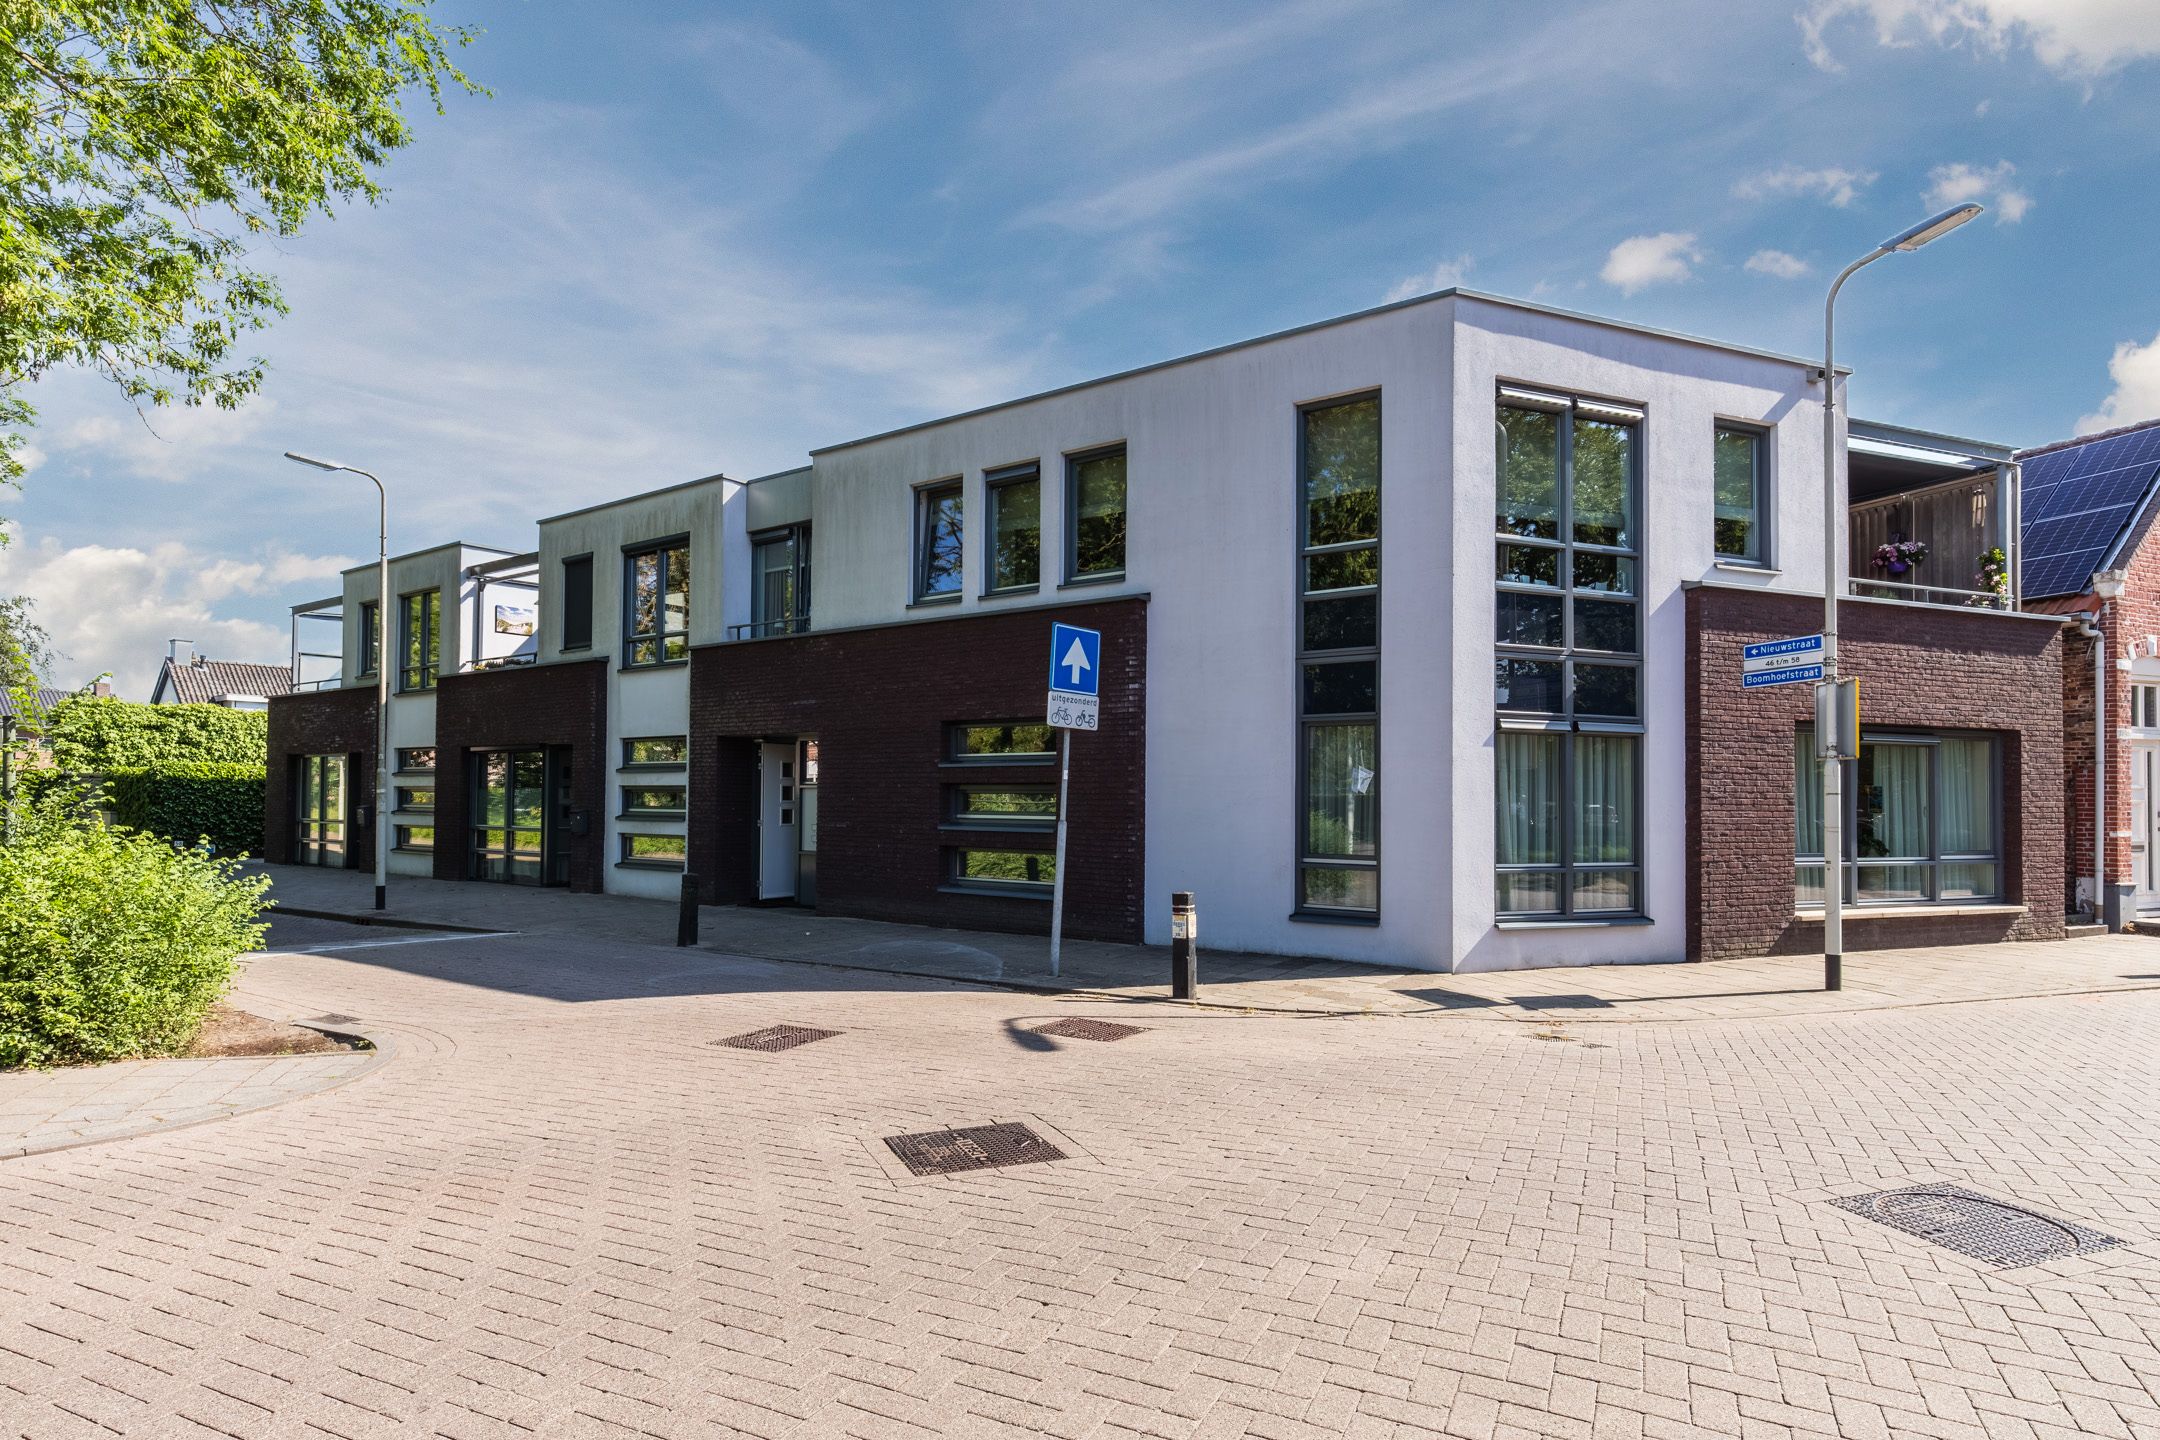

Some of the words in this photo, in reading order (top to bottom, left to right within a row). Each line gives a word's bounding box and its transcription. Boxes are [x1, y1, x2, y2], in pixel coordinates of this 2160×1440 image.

[1760, 639, 1815, 653] Nieuwstraat
[1746, 668, 1819, 684] Boomhoefstraat
[1052, 694, 1097, 706] uitgezonderd
